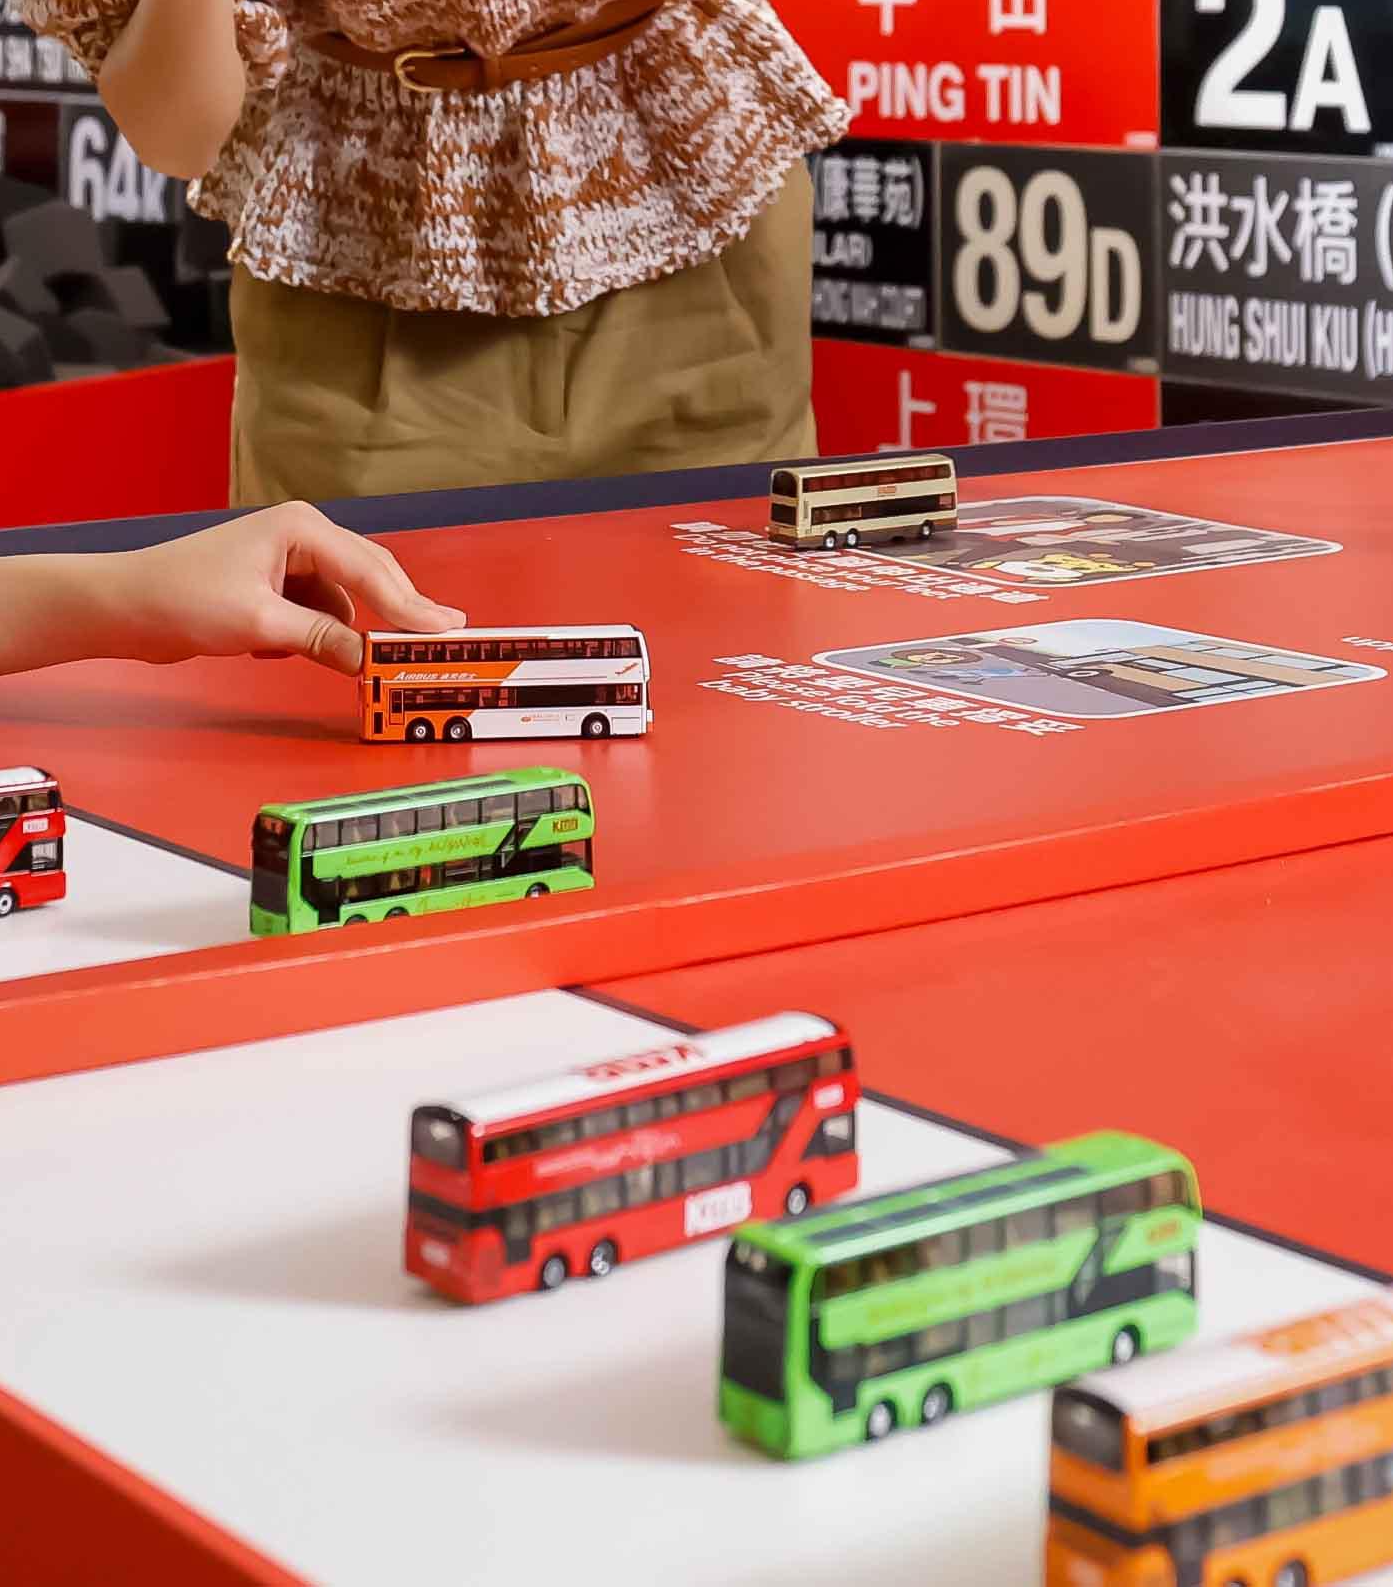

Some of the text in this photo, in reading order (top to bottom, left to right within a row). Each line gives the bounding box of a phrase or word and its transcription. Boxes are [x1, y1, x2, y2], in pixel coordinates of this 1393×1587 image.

[847, 60, 1062, 127] PING TIN
[952, 164, 1143, 345] 89D
[1167, 170, 1359, 286] 洪水橋
[1168, 291, 1241, 360] HUNG
[1242, 295, 1307, 368] SHUI
[1310, 301, 1359, 373] KIU
[696, 679, 912, 730] baby stroller
